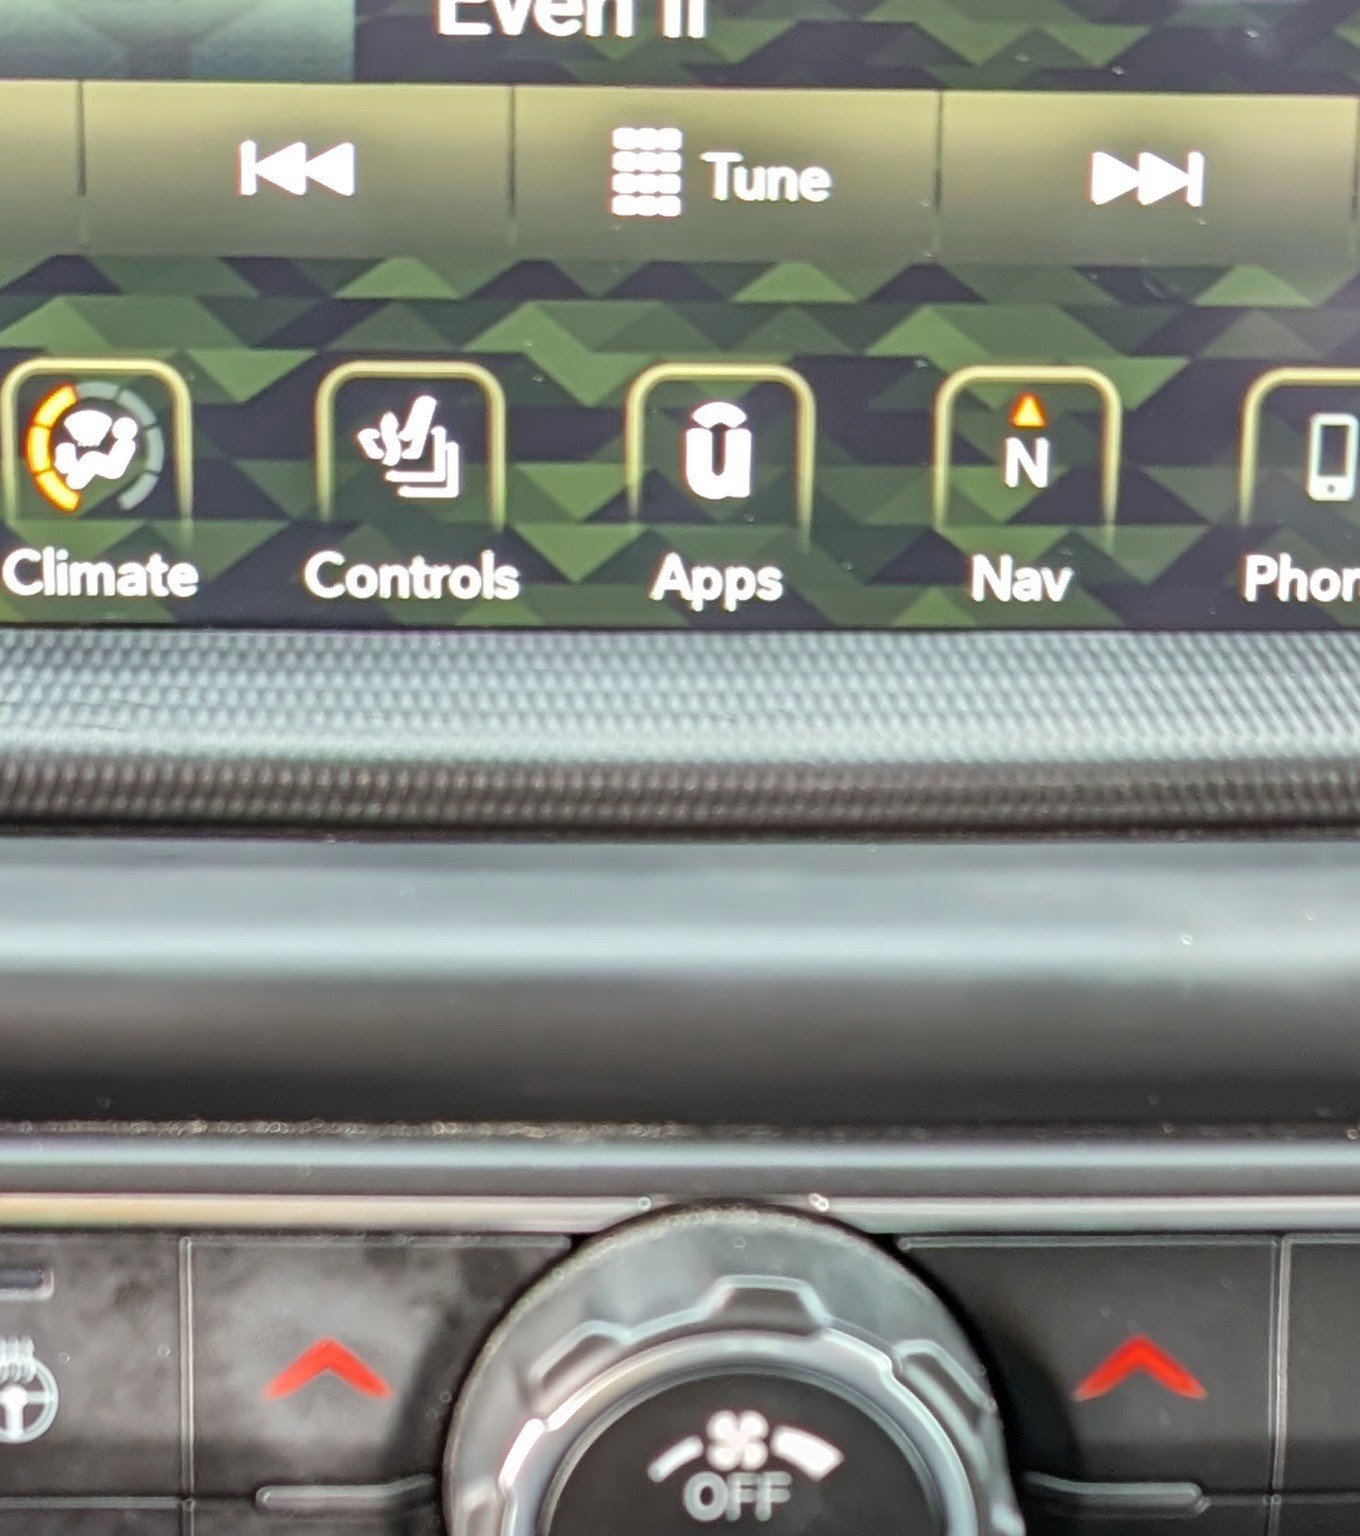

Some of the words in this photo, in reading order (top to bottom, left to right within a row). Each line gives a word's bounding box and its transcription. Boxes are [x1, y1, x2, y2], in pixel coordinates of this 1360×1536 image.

[701, 152, 833, 203] Tune
[1004, 437, 1050, 489] N
[1, 547, 200, 599] Climate
[303, 550, 521, 601] Controls
[649, 551, 785, 613] Apps
[971, 555, 1073, 603] Nav
[682, 1470, 792, 1523] OFF
